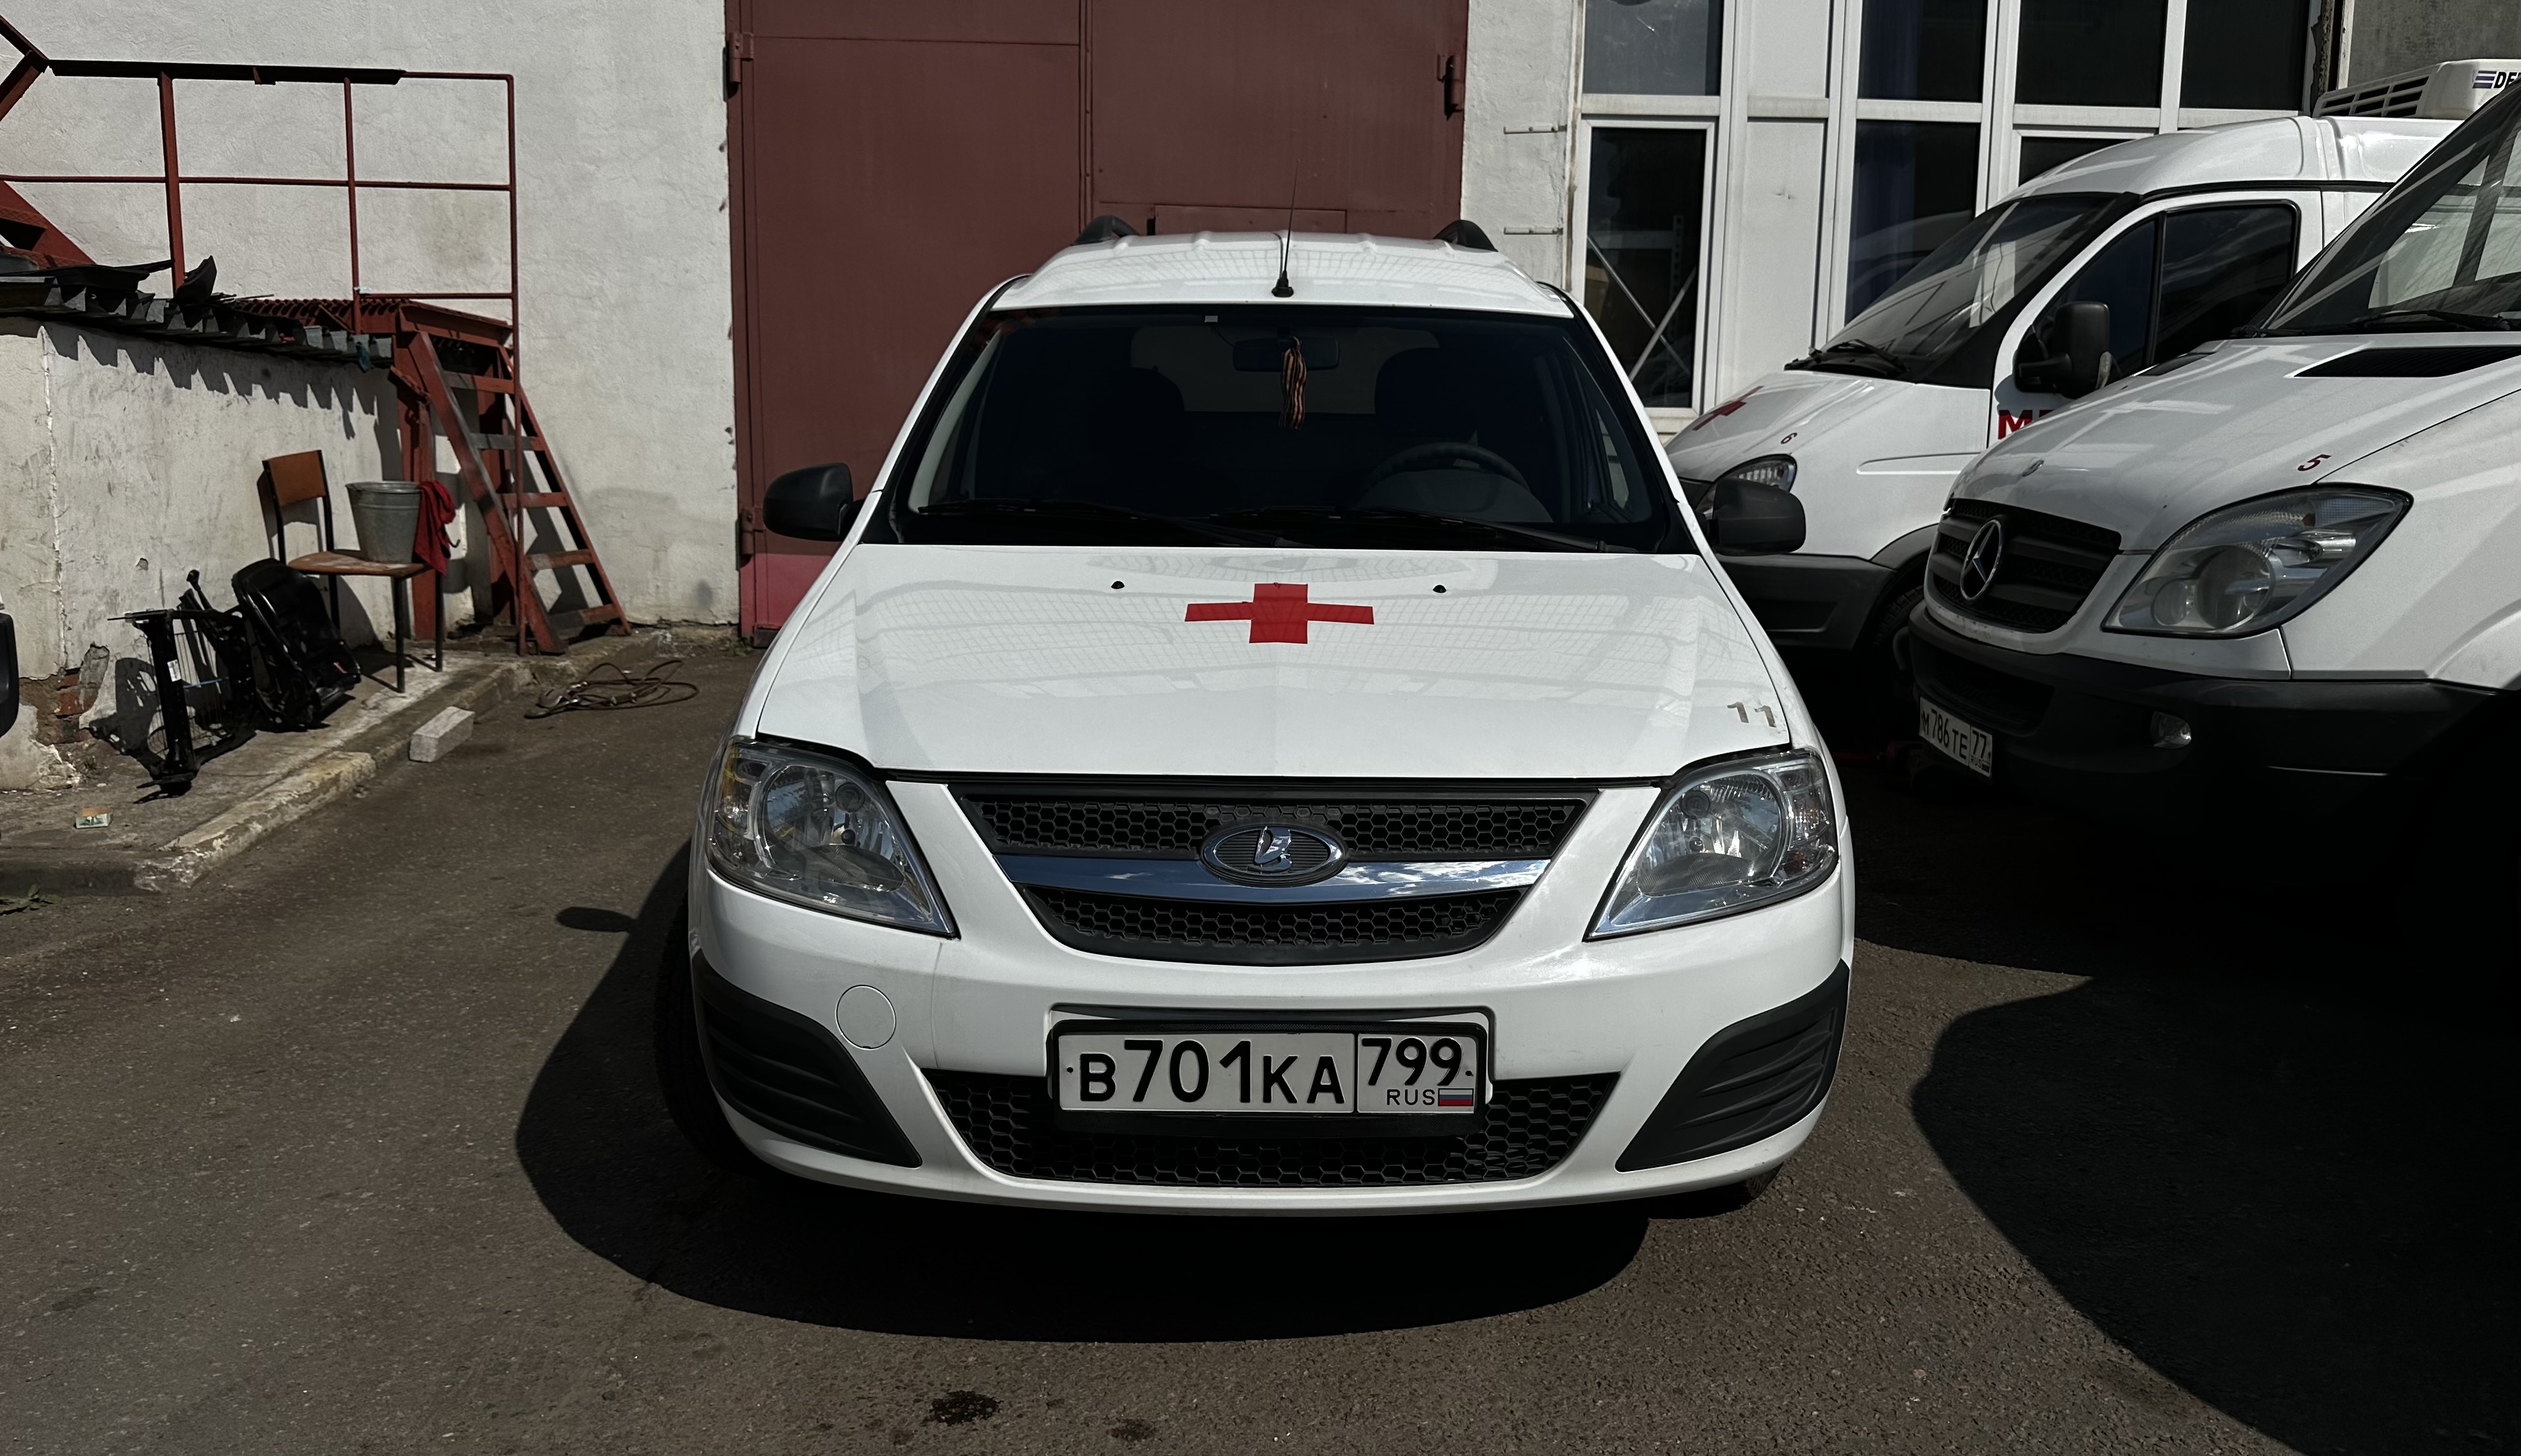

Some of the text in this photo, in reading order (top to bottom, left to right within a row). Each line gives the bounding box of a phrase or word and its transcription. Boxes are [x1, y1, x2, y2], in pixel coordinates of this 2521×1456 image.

[1781, 432, 1798, 444] 6
[2298, 454, 2332, 471] 5
[1727, 702, 1776, 727] 11
[1972, 729, 1987, 759] 77
[1971, 756, 1982, 768] RUS
[1361, 1037, 1463, 1087] 799
[1387, 1089, 1435, 1106] RUS
